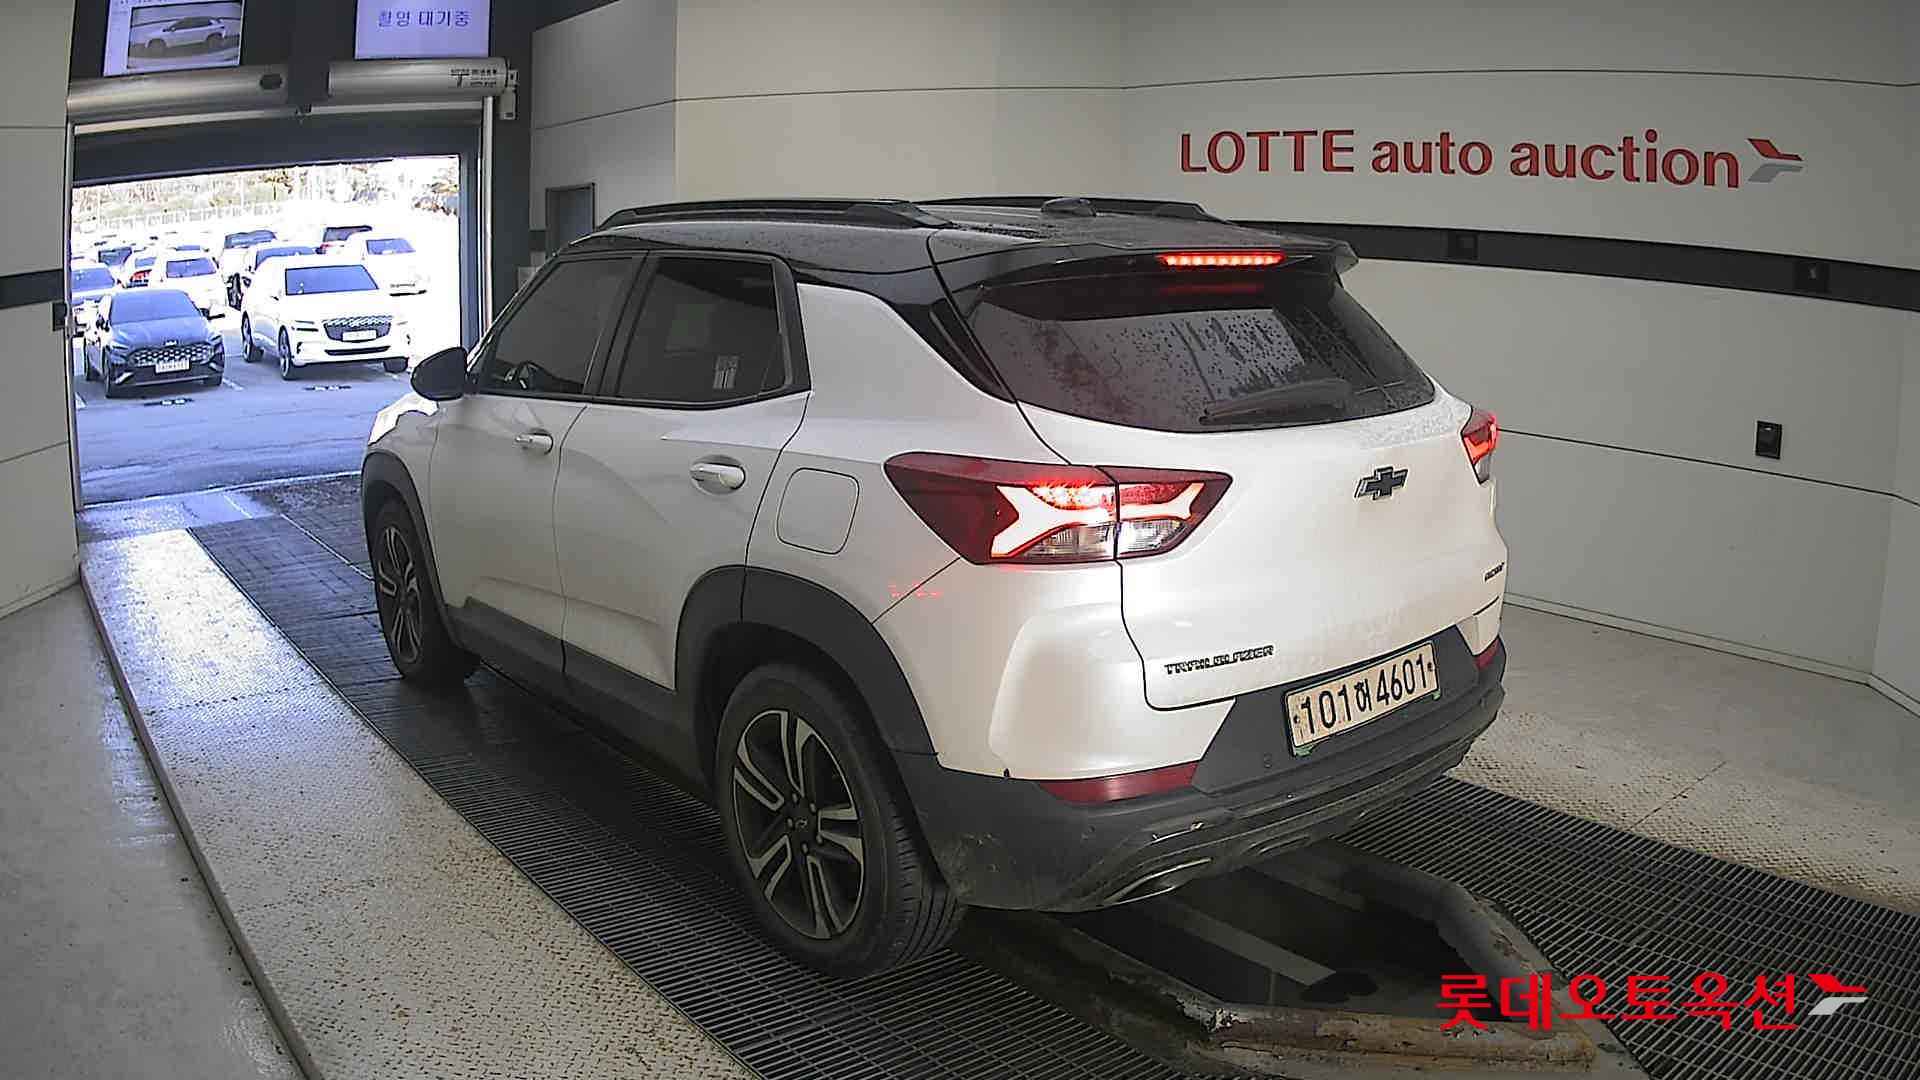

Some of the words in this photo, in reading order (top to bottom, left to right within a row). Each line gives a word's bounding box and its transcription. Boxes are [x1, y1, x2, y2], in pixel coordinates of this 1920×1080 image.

[418, 10, 470, 28] 대기중
[1180, 129, 1355, 174] LOTTE
[1371, 131, 1494, 175] auto
[1509, 129, 1740, 189] auction
